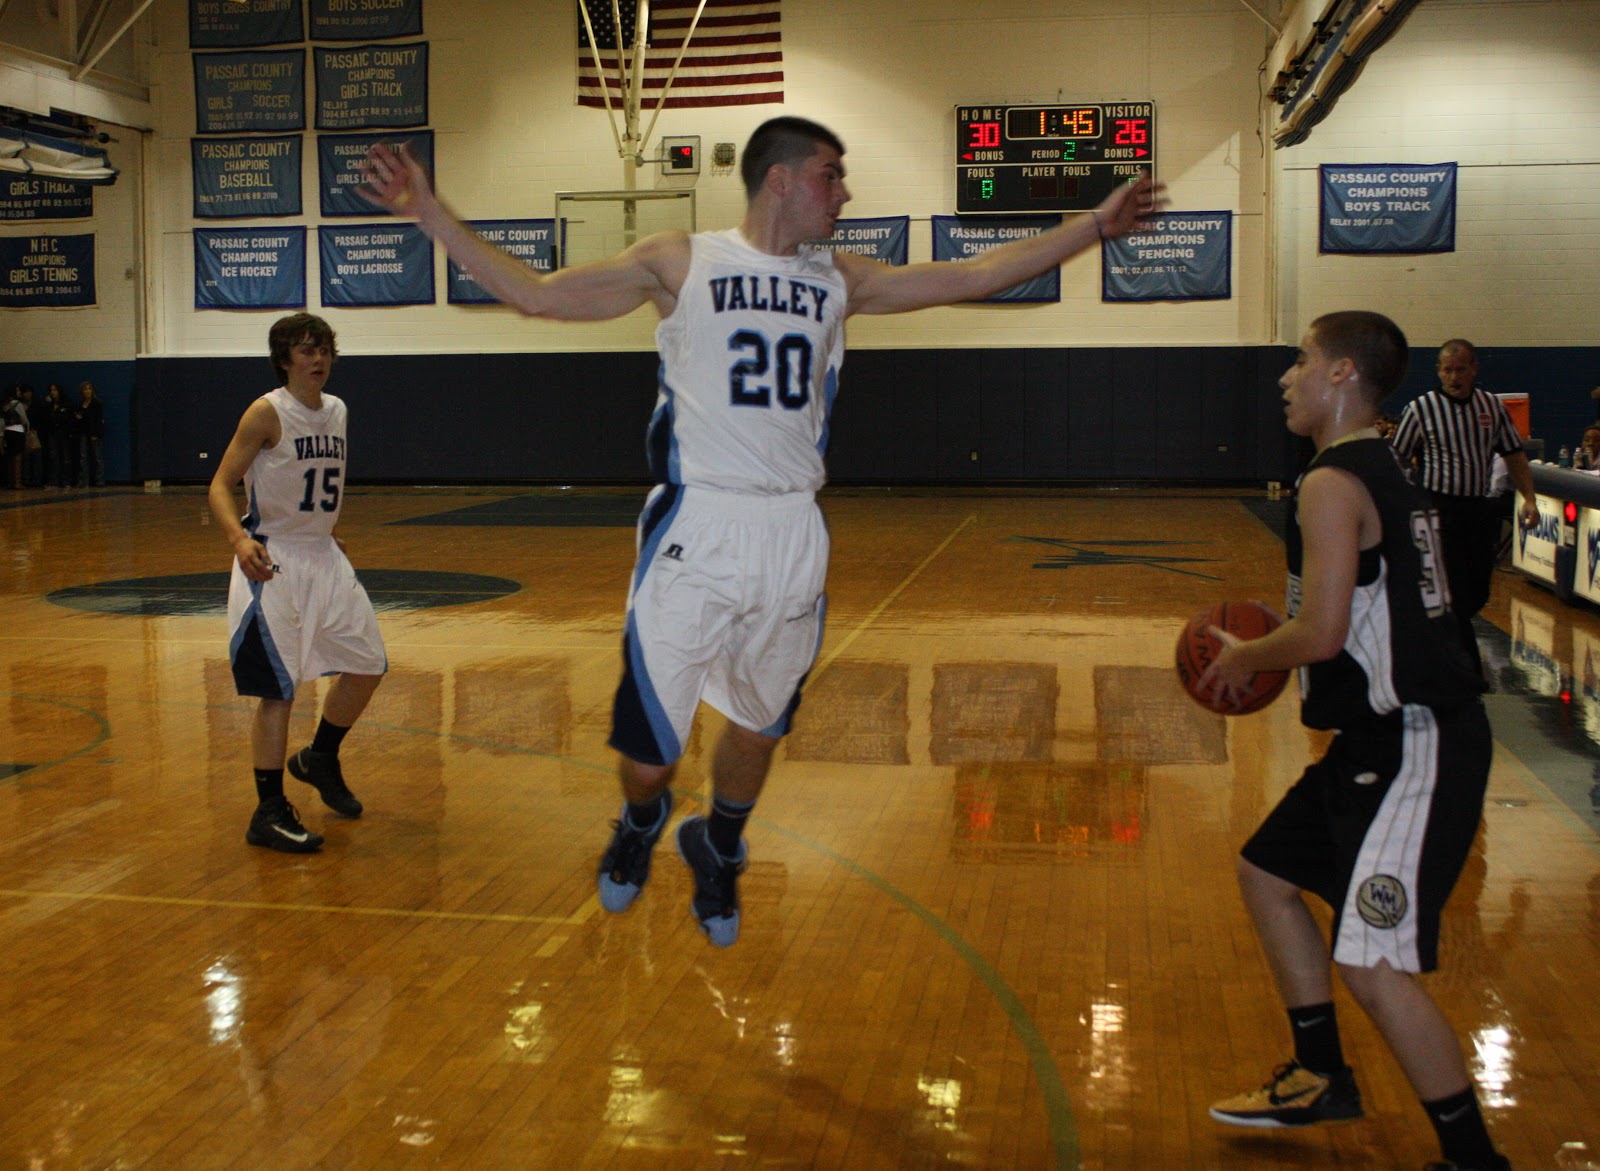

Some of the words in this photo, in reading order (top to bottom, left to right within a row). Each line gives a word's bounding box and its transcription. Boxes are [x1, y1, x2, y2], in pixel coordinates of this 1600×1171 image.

[324, 52, 369, 69] PASSAIC
[374, 50, 417, 66] COUNTY
[206, 64, 248, 80] PASSAIC
[252, 63, 294, 78] COUNTY
[348, 68, 395, 82] CHAMPIONS
[228, 80, 272, 92] CHAMPIONS
[340, 82, 368, 99] GIRLS
[372, 81, 403, 96] TRACK
[208, 96, 233, 110] GIRLS
[252, 94, 291, 108] SOCCER
[961, 108, 1002, 120] HOME
[1105, 105, 1150, 118] VISITOR
[968, 122, 1001, 148] 30
[1114, 120, 1147, 144] 26
[202, 144, 244, 158] PASSAIC
[249, 142, 290, 158] COUNTY
[334, 144, 368, 156] PASSAIC
[974, 150, 1004, 161] BONUS
[1031, 149, 1060, 159] PERIOD
[1064, 141, 1076, 160] 2
[1104, 148, 1134, 158] BONUS
[224, 160, 270, 171] CHAMPIONS
[967, 168, 995, 178] FOULS
[1022, 167, 1056, 177] PLAYER
[1063, 166, 1091, 176] FOULS
[1113, 165, 1141, 175] FOULS
[220, 174, 274, 188] BASEBALL
[336, 174, 360, 184] GIRLS
[1330, 173, 1387, 184] PASSAIC
[1390, 172, 1446, 183] COUNTY
[10, 181, 39, 196] GIRLS
[982, 180, 994, 199] 8
[1348, 187, 1428, 198] CHAMPIONS
[1345, 202, 1381, 212] BOYS
[1386, 201, 1431, 212] TRACK
[1168, 220, 1222, 231] COUNTY
[1330, 218, 1352, 226] RELAY
[508, 229, 548, 241] COUNTY
[848, 228, 891, 240] COUNTY
[950, 228, 994, 239] PASSAIC
[998, 227, 1042, 239] COUNTY
[209, 238, 249, 249] PASSAIC
[252, 236, 290, 248] COUNTY
[334, 235, 370, 246] PASSAIC
[371, 234, 404, 245] COUNTY
[1128, 234, 1206, 246] CHAMPIONS
[22, 255, 66, 266] CHAMPIONS
[221, 252, 278, 263] CHAMPIONS
[346, 249, 396, 260] CHAMPIONS
[1138, 248, 1194, 260] FENCING
[221, 266, 238, 277] ICE
[240, 265, 278, 277] HOCKEY
[337, 264, 359, 275] BOYS
[361, 262, 404, 274] LACROSSE
[10, 268, 40, 284] GIRLS
[43, 268, 78, 282] TENNIS
[708, 276, 829, 323] VALLEY
[728, 328, 813, 411] 20
[294, 434, 345, 461] VALLEY
[298, 467, 340, 512] 15
